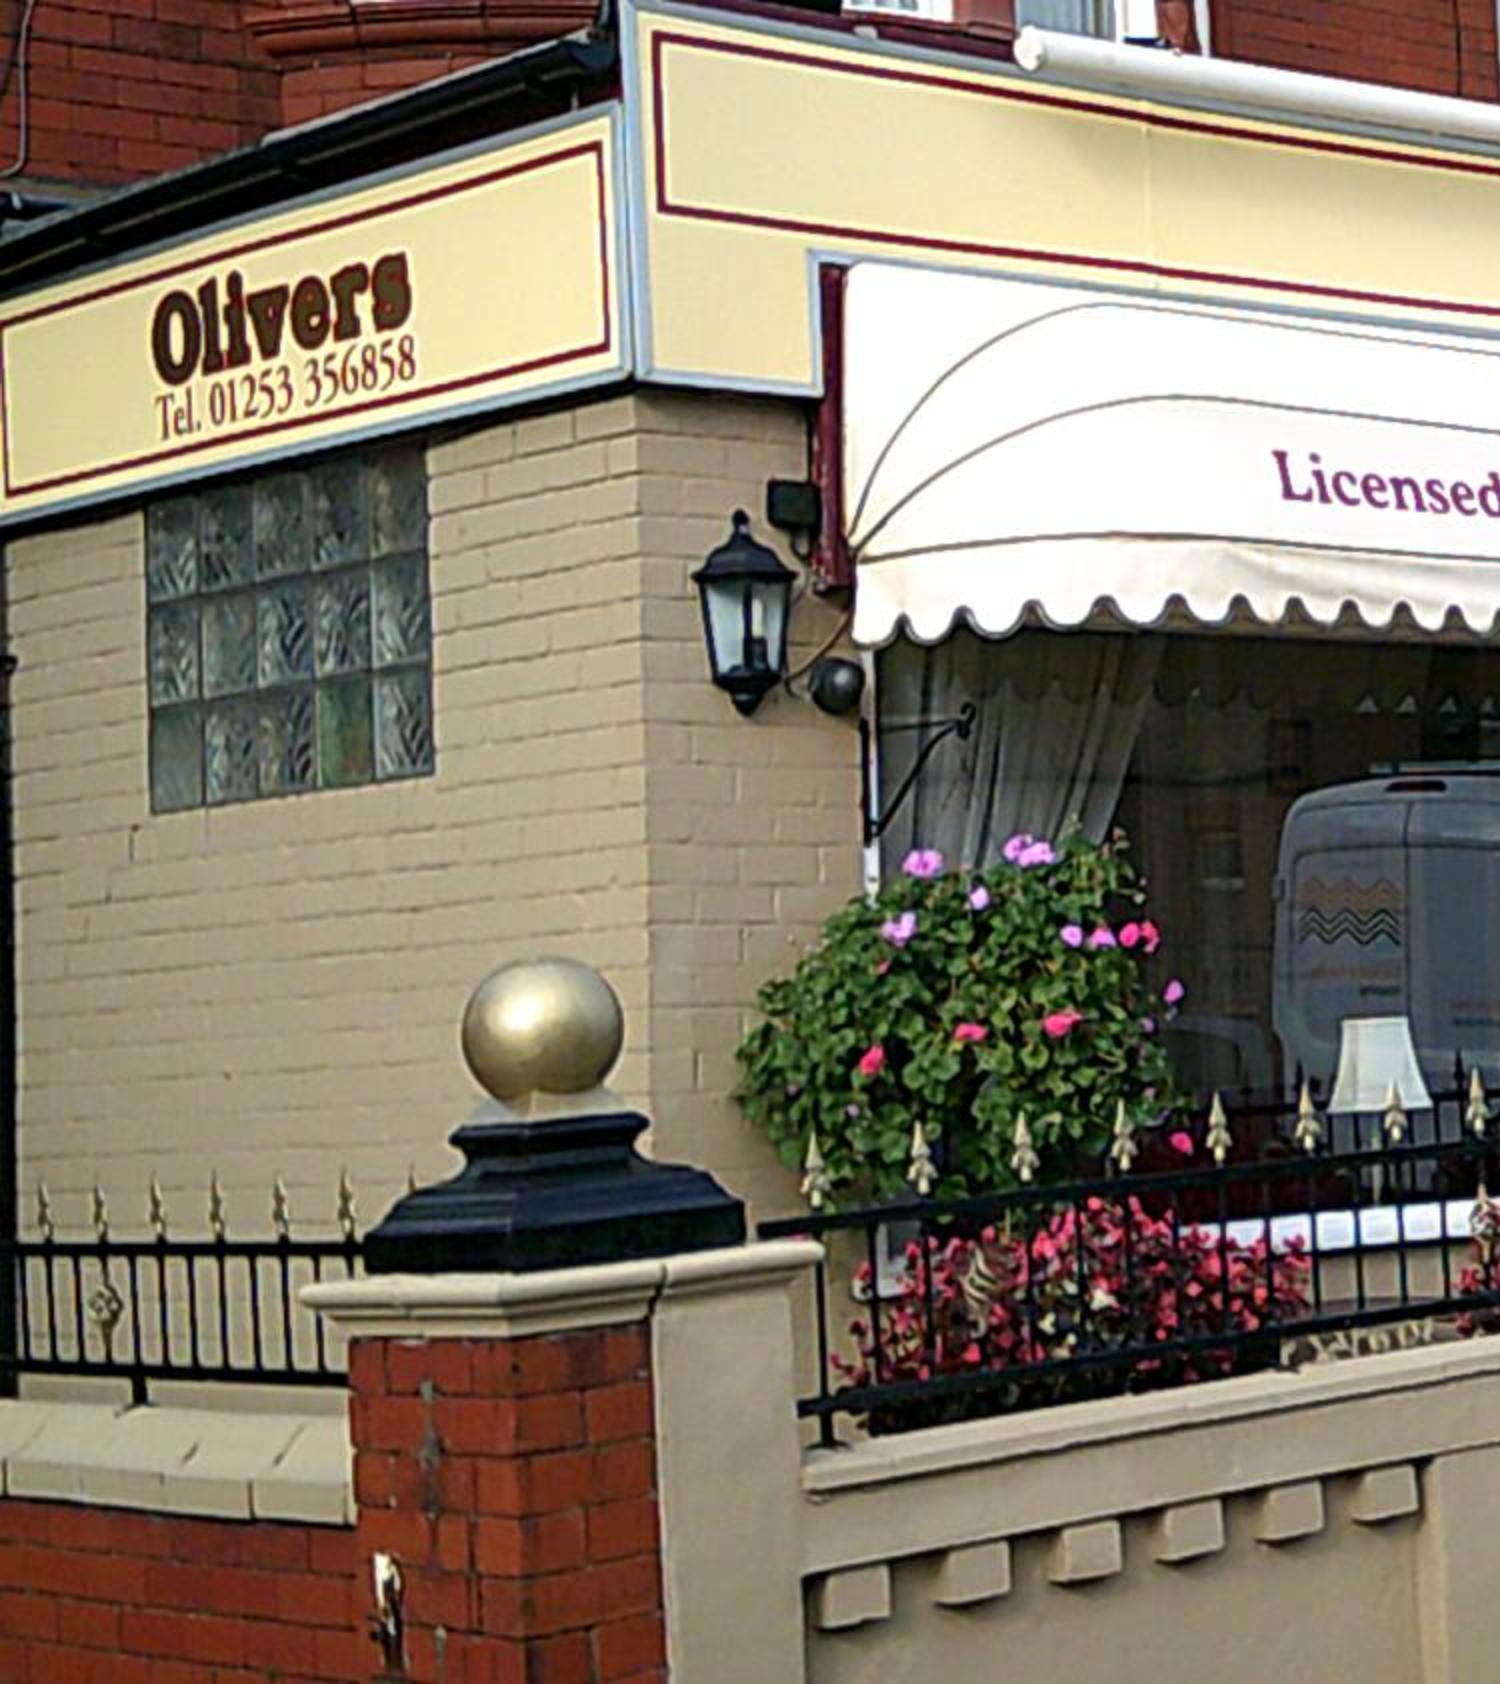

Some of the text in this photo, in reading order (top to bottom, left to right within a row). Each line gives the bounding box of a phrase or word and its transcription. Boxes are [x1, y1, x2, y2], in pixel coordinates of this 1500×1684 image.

[152, 251, 412, 386] Olivers
[156, 334, 416, 442] Tel. 01253 356858
